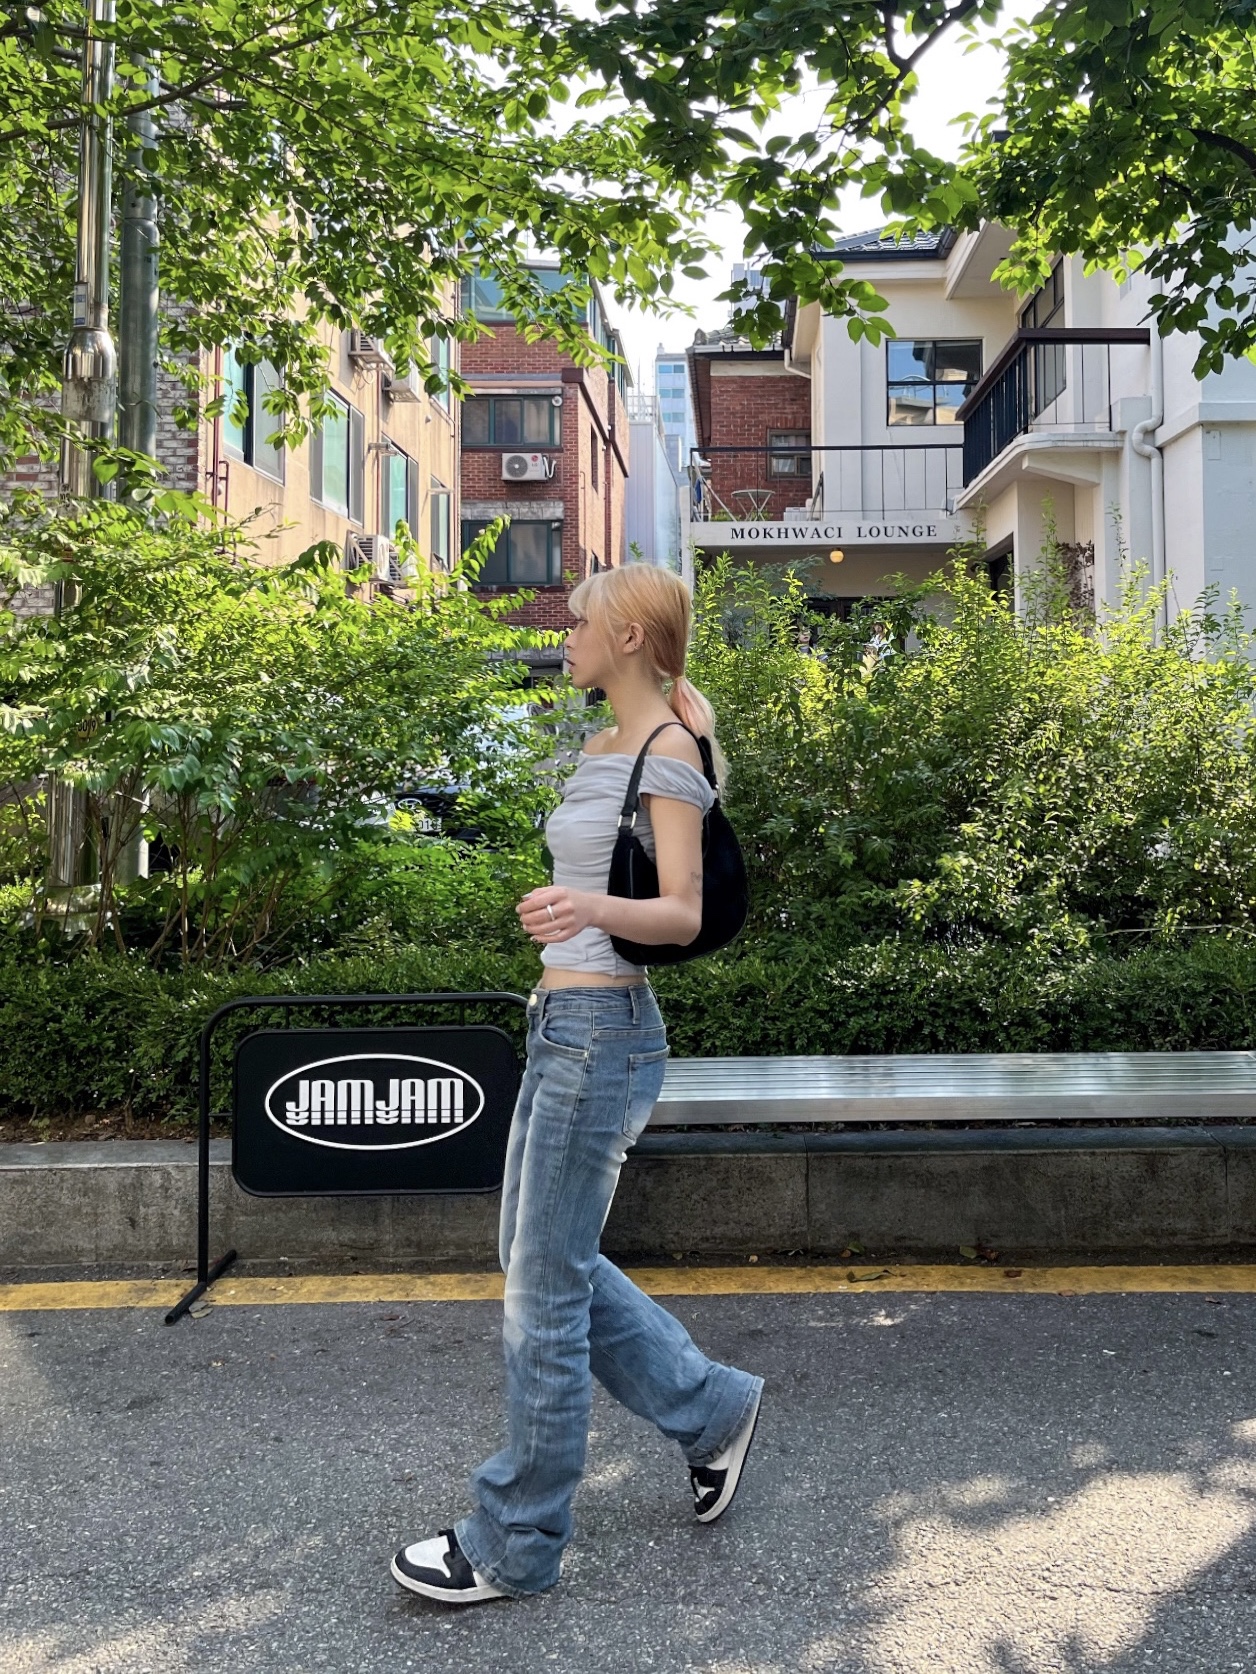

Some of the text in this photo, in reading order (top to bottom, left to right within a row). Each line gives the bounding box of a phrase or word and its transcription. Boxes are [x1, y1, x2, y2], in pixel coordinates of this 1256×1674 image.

[731, 524, 938, 540] MOKHWACI LOUNGE
[285, 1077, 464, 1126] JAMJAM
